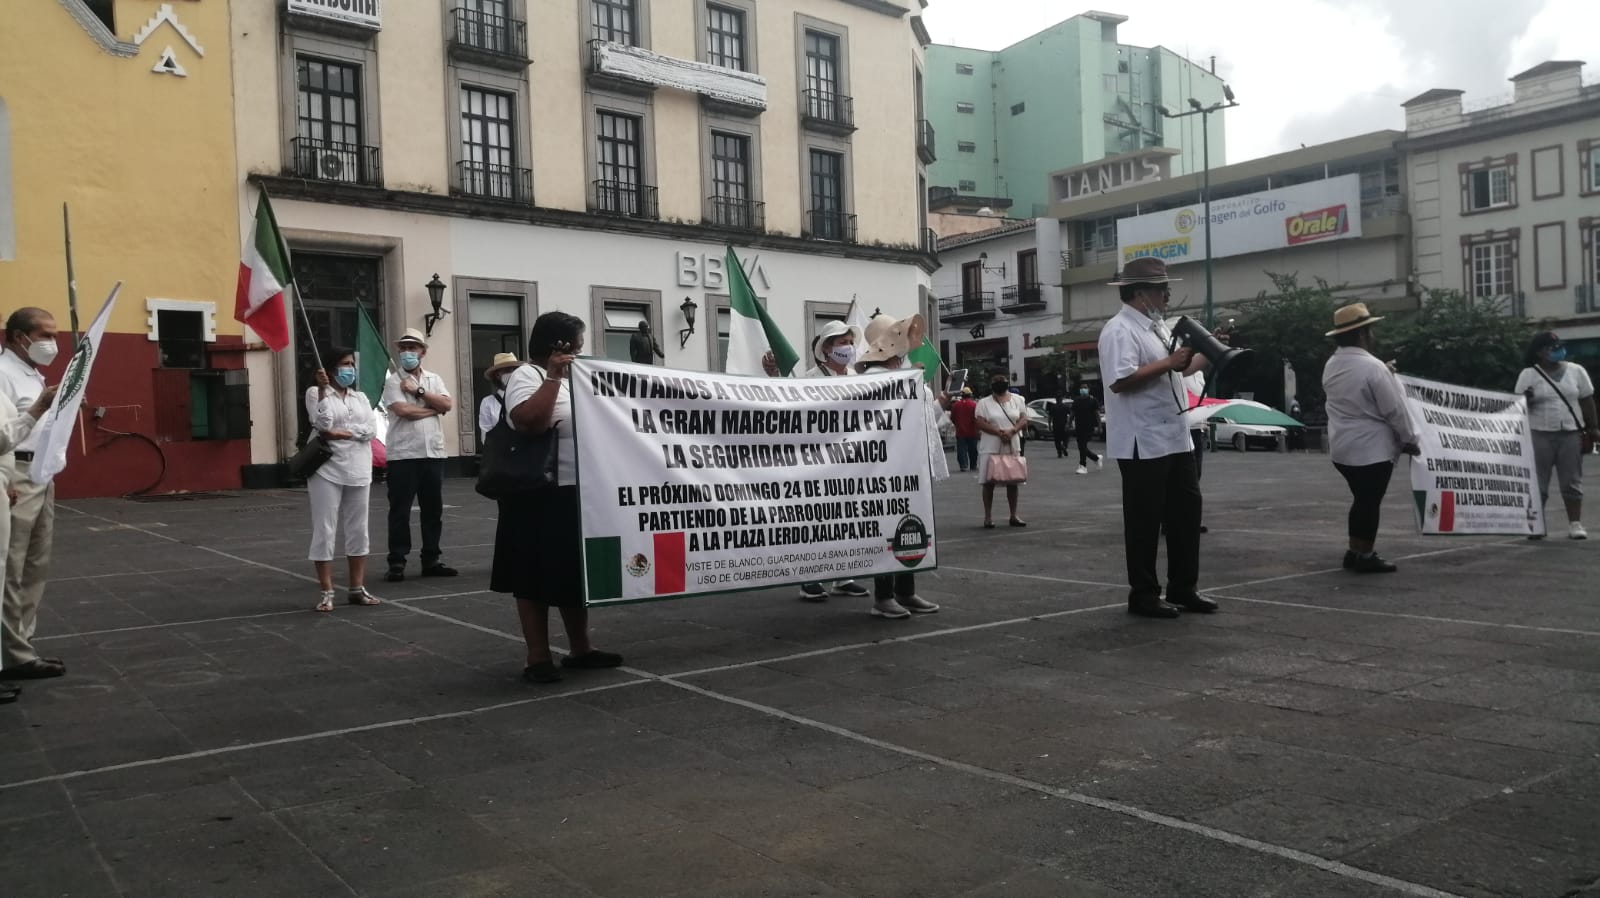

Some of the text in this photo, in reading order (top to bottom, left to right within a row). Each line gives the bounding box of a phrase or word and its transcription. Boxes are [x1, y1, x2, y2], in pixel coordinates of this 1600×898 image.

[1253, 200, 1286, 216] Golfo
[591, 370, 918, 402] INVITAMOS A TODA LA CIUDADANÍA A
[631, 408, 904, 435] LA GRAN MARCHA POR LA PAZ Y
[661, 438, 888, 469] LA SEGURIDAD EN MÉXICO
[618, 474, 919, 506] EL PRÓXIMO DOMINGO 24 DE JULIO A LAS 10 AM
[638, 497, 910, 532] PARTIENDO DE LA PARROQUIA DE SAN JOSE
[689, 533, 700, 552] A
[702, 532, 720, 551] LA
[723, 528, 767, 550] PLAZA
[900, 531, 922, 546] FRENA
[685, 546, 884, 572] VISTE DE BLANCO, GUARDANDO LA SANA DISTANCIA
[697, 575, 717, 585] USO
[719, 573, 732, 583] DE
[733, 568, 790, 582] CUBREBOCAS
[791, 566, 798, 576] Y
[798, 563, 834, 575] BANDERA
[836, 562, 846, 571] DE
